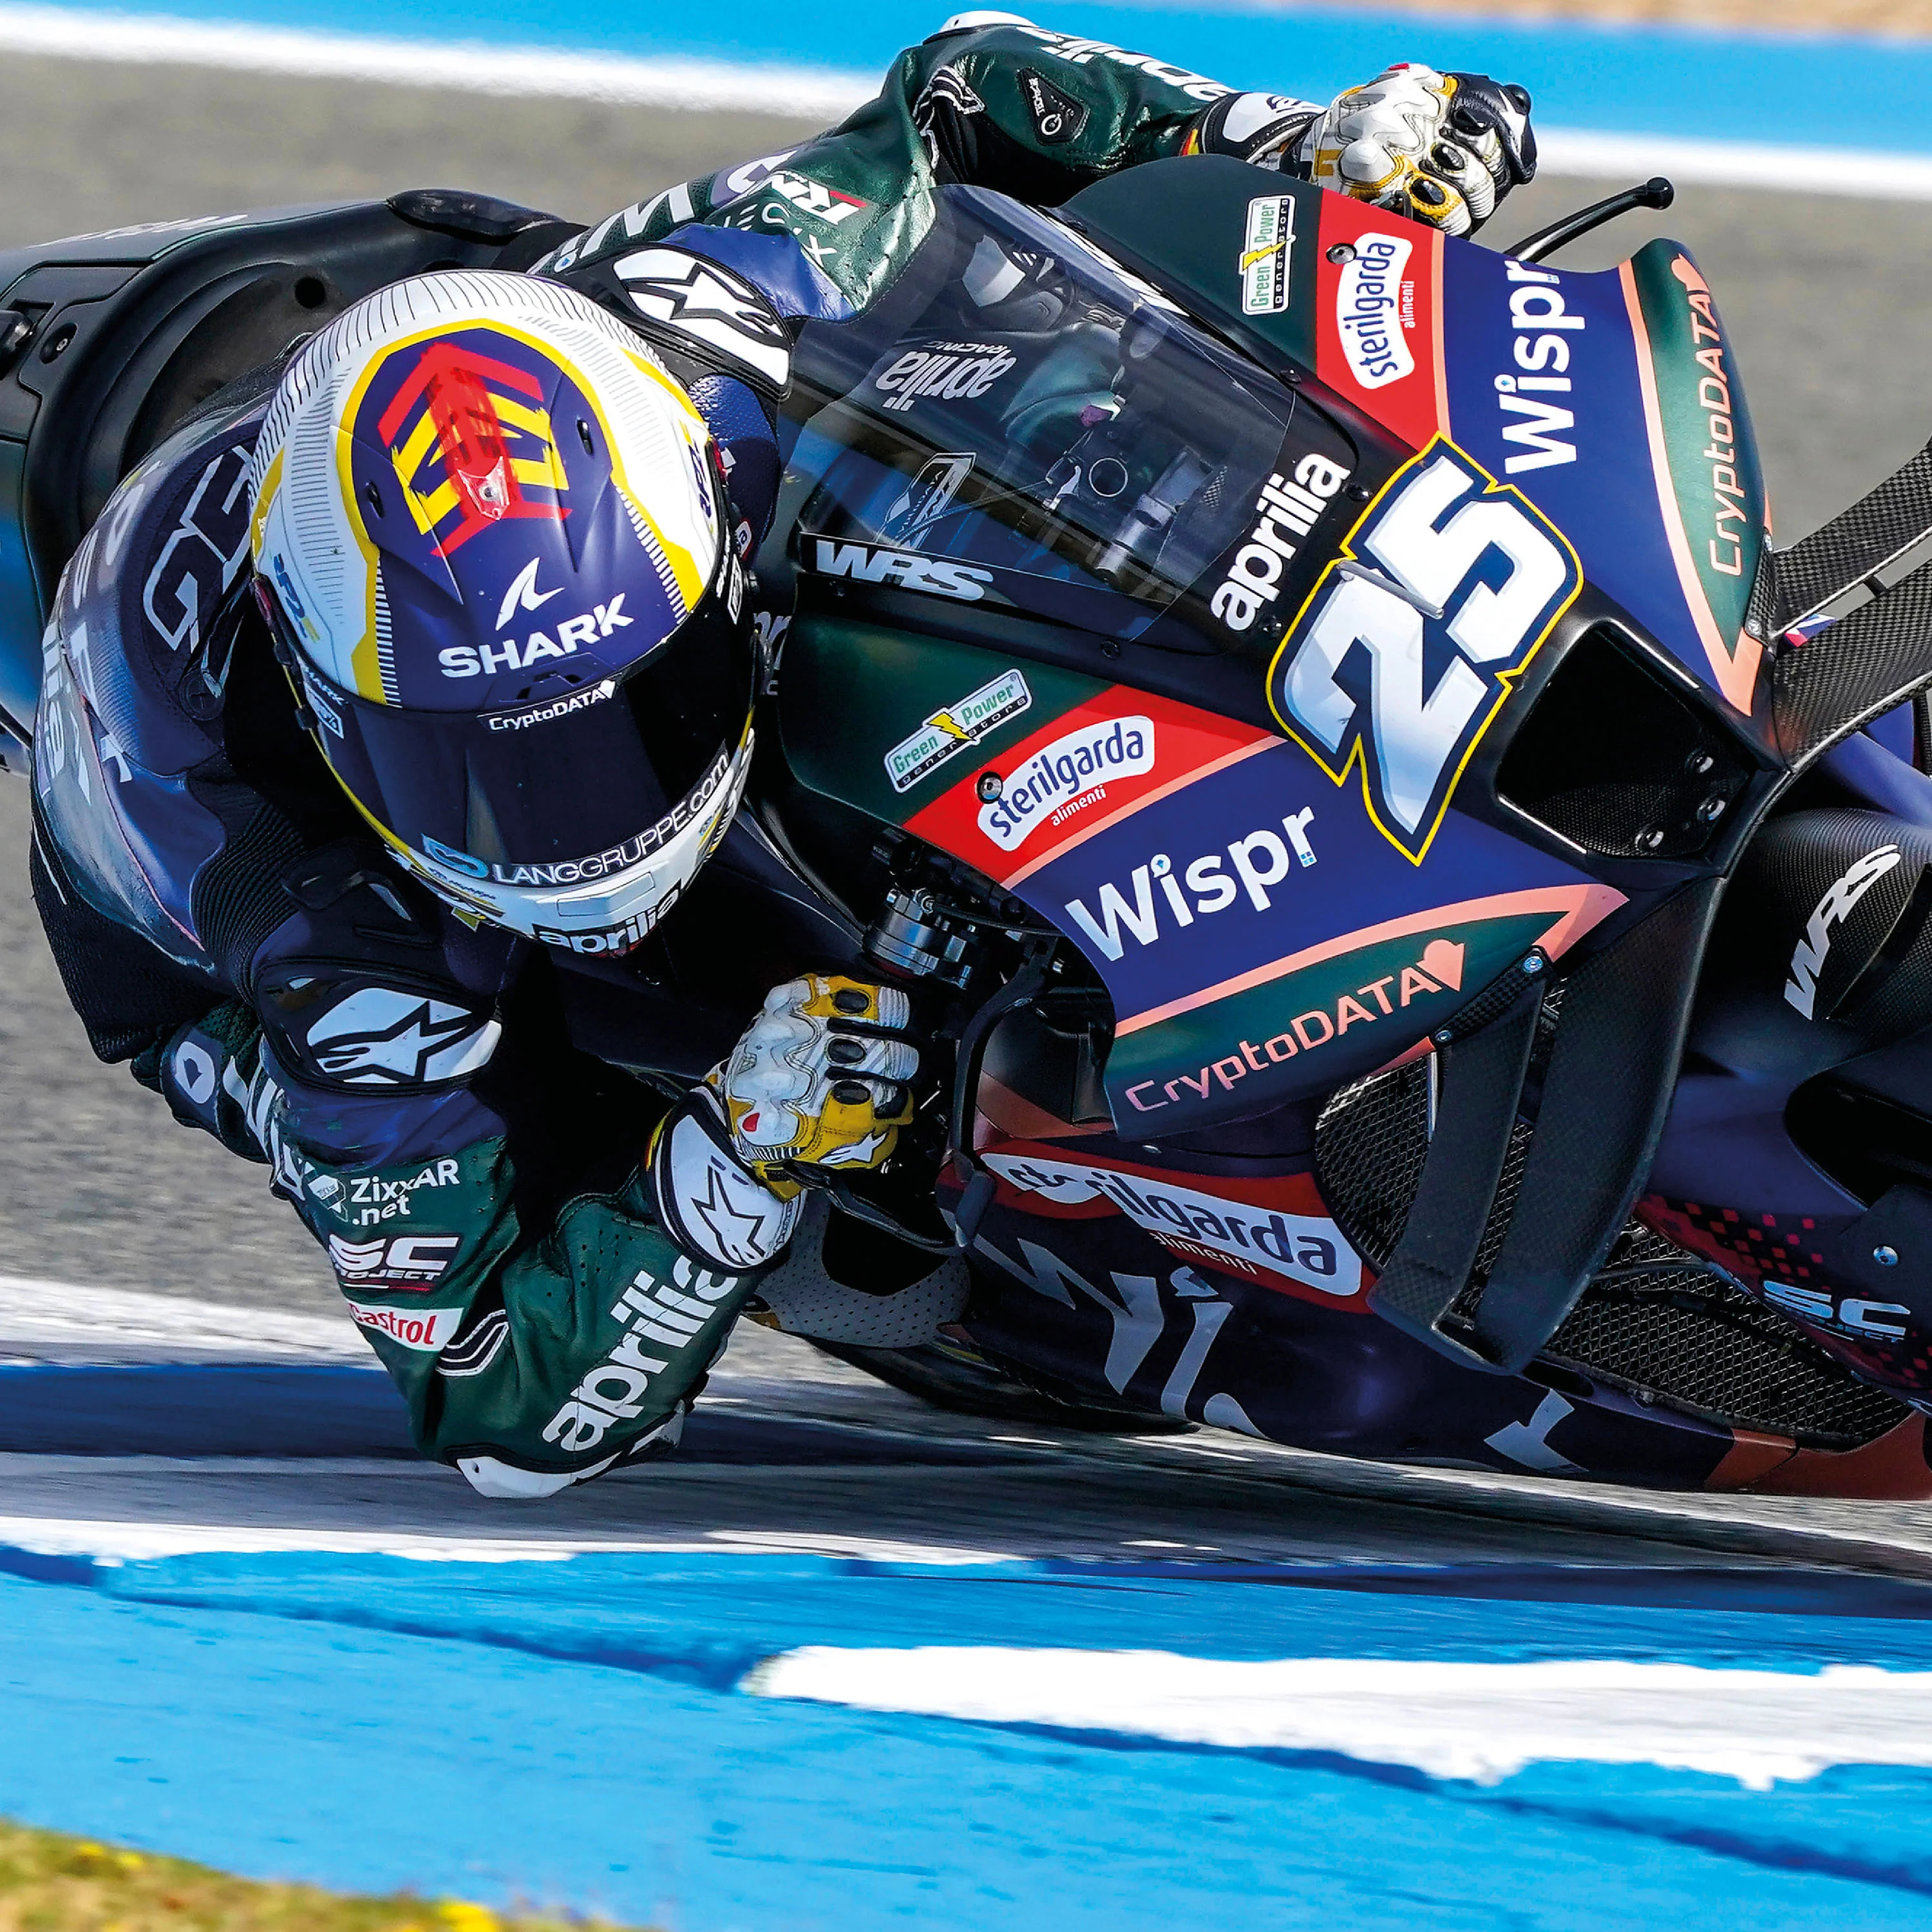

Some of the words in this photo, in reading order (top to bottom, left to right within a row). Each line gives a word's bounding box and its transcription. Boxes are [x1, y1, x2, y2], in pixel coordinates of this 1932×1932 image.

[1254, 204, 1275, 243] Power
[1251, 265, 1271, 307] Green
[1343, 242, 1399, 377] sterilgarda
[1399, 279, 1416, 329] alimenti
[875, 350, 1018, 412] aprilia
[922, 340, 1012, 358] RACING
[1493, 259, 1586, 475] Wispr
[1685, 289, 1747, 578] CryptoDATA
[815, 538, 994, 601] WRS
[1210, 452, 1352, 631] aprilia
[437, 592, 635, 679] SHARK
[1284, 455, 1567, 835] 25
[488, 686, 607, 733] CryptoDATA
[893, 734, 939, 773] Green
[960, 684, 1014, 726] Power
[493, 753, 728, 885] LANGGRUPPE.com
[989, 722, 1144, 838] sterilgarda
[1050, 785, 1107, 826] alimenti
[538, 889, 679, 954] aprilia
[1064, 806, 1318, 961] Wispr
[1783, 844, 1901, 1021] WRS
[1124, 965, 1443, 1113] CryptoDATA
[329, 1233, 460, 1272] SC
[1763, 1280, 1911, 1336] SC
[542, 1254, 739, 1452] aprilia
